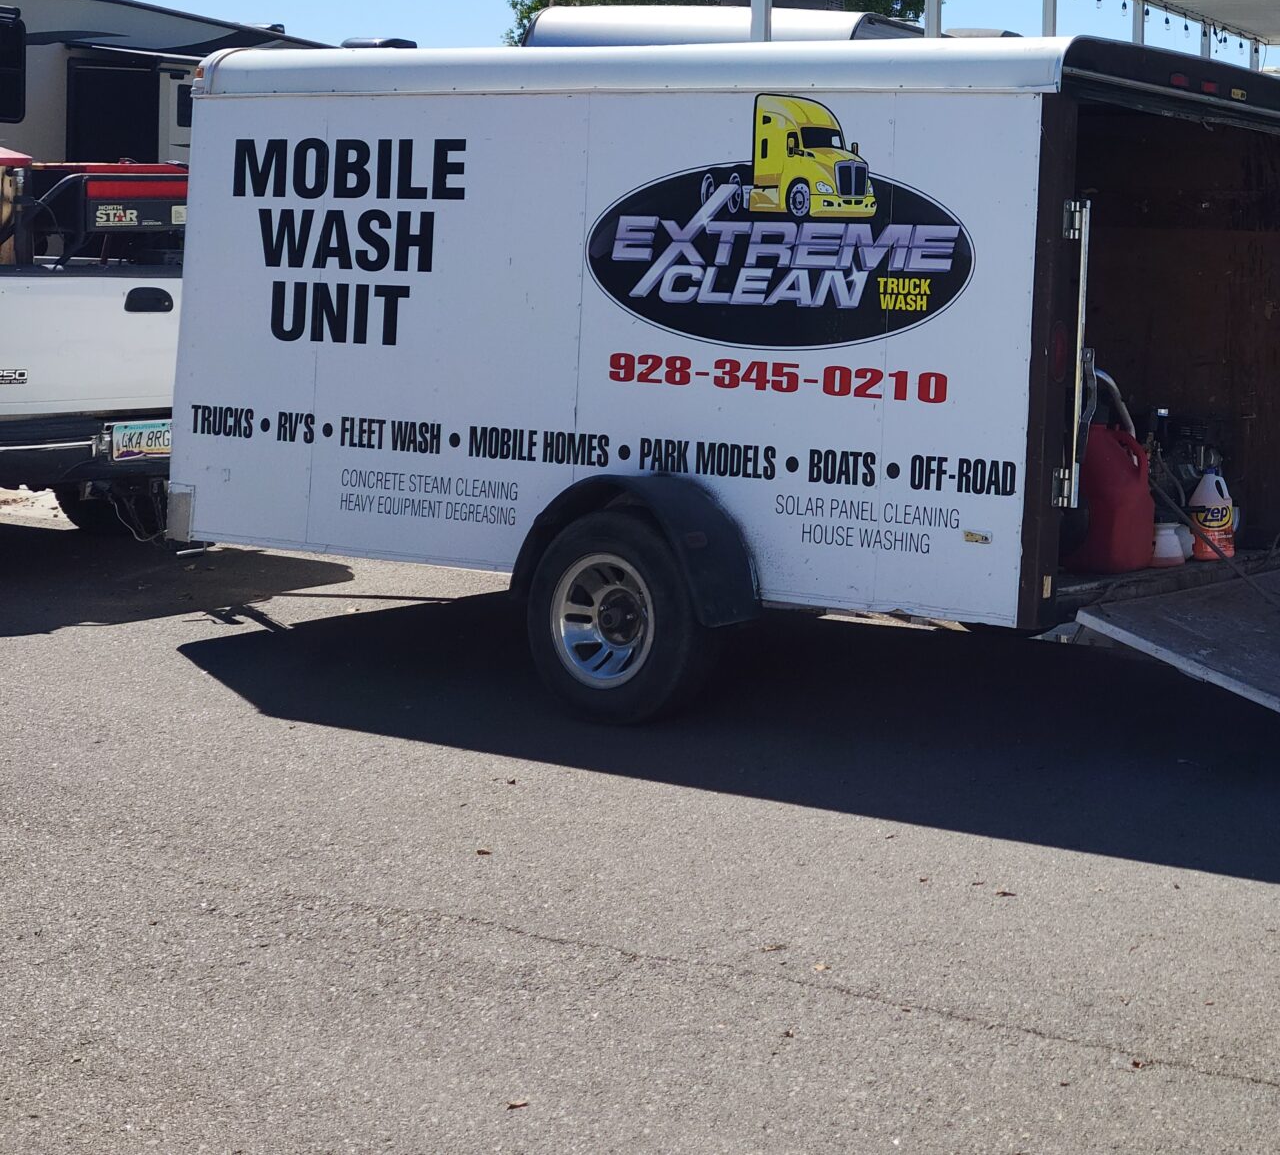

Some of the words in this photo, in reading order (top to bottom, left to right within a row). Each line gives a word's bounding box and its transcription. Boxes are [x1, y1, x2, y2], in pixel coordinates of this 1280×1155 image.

[233, 138, 467, 200] MOBILE
[96, 209, 137, 222] STAR
[258, 209, 435, 272] WASH
[658, 265, 869, 309] CLEAN
[878, 278, 931, 295] TRUCK
[880, 295, 927, 311] WASH
[271, 281, 410, 346] UNIT
[0, 370, 28, 380] 50
[609, 353, 948, 404] 928-345-0210
[192, 405, 254, 438] TRUCKS
[277, 412, 315, 443] RV'S
[340, 417, 386, 449] FLEET
[391, 421, 441, 454] WASH
[469, 426, 537, 461] MOBILE
[542, 431, 609, 467] HOMES
[639, 438, 689, 474] PARK
[695, 442, 776, 480] MODELS
[341, 469, 405, 491] CONCRETE
[409, 474, 451, 495] STEAM
[456, 478, 518, 501] CLEANING
[809, 449, 876, 486] BOATS
[910, 455, 1016, 496] OFF-ROAD
[340, 493, 374, 513] HEAVY
[378, 496, 442, 519] EQUIPMENT
[445, 501, 517, 526] DEGREASING
[775, 495, 824, 517] SOLAR
[830, 499, 878, 522] PANEL
[883, 503, 960, 529] CLEANING
[801, 524, 854, 547] HOUSE
[858, 529, 930, 554] WASHING
